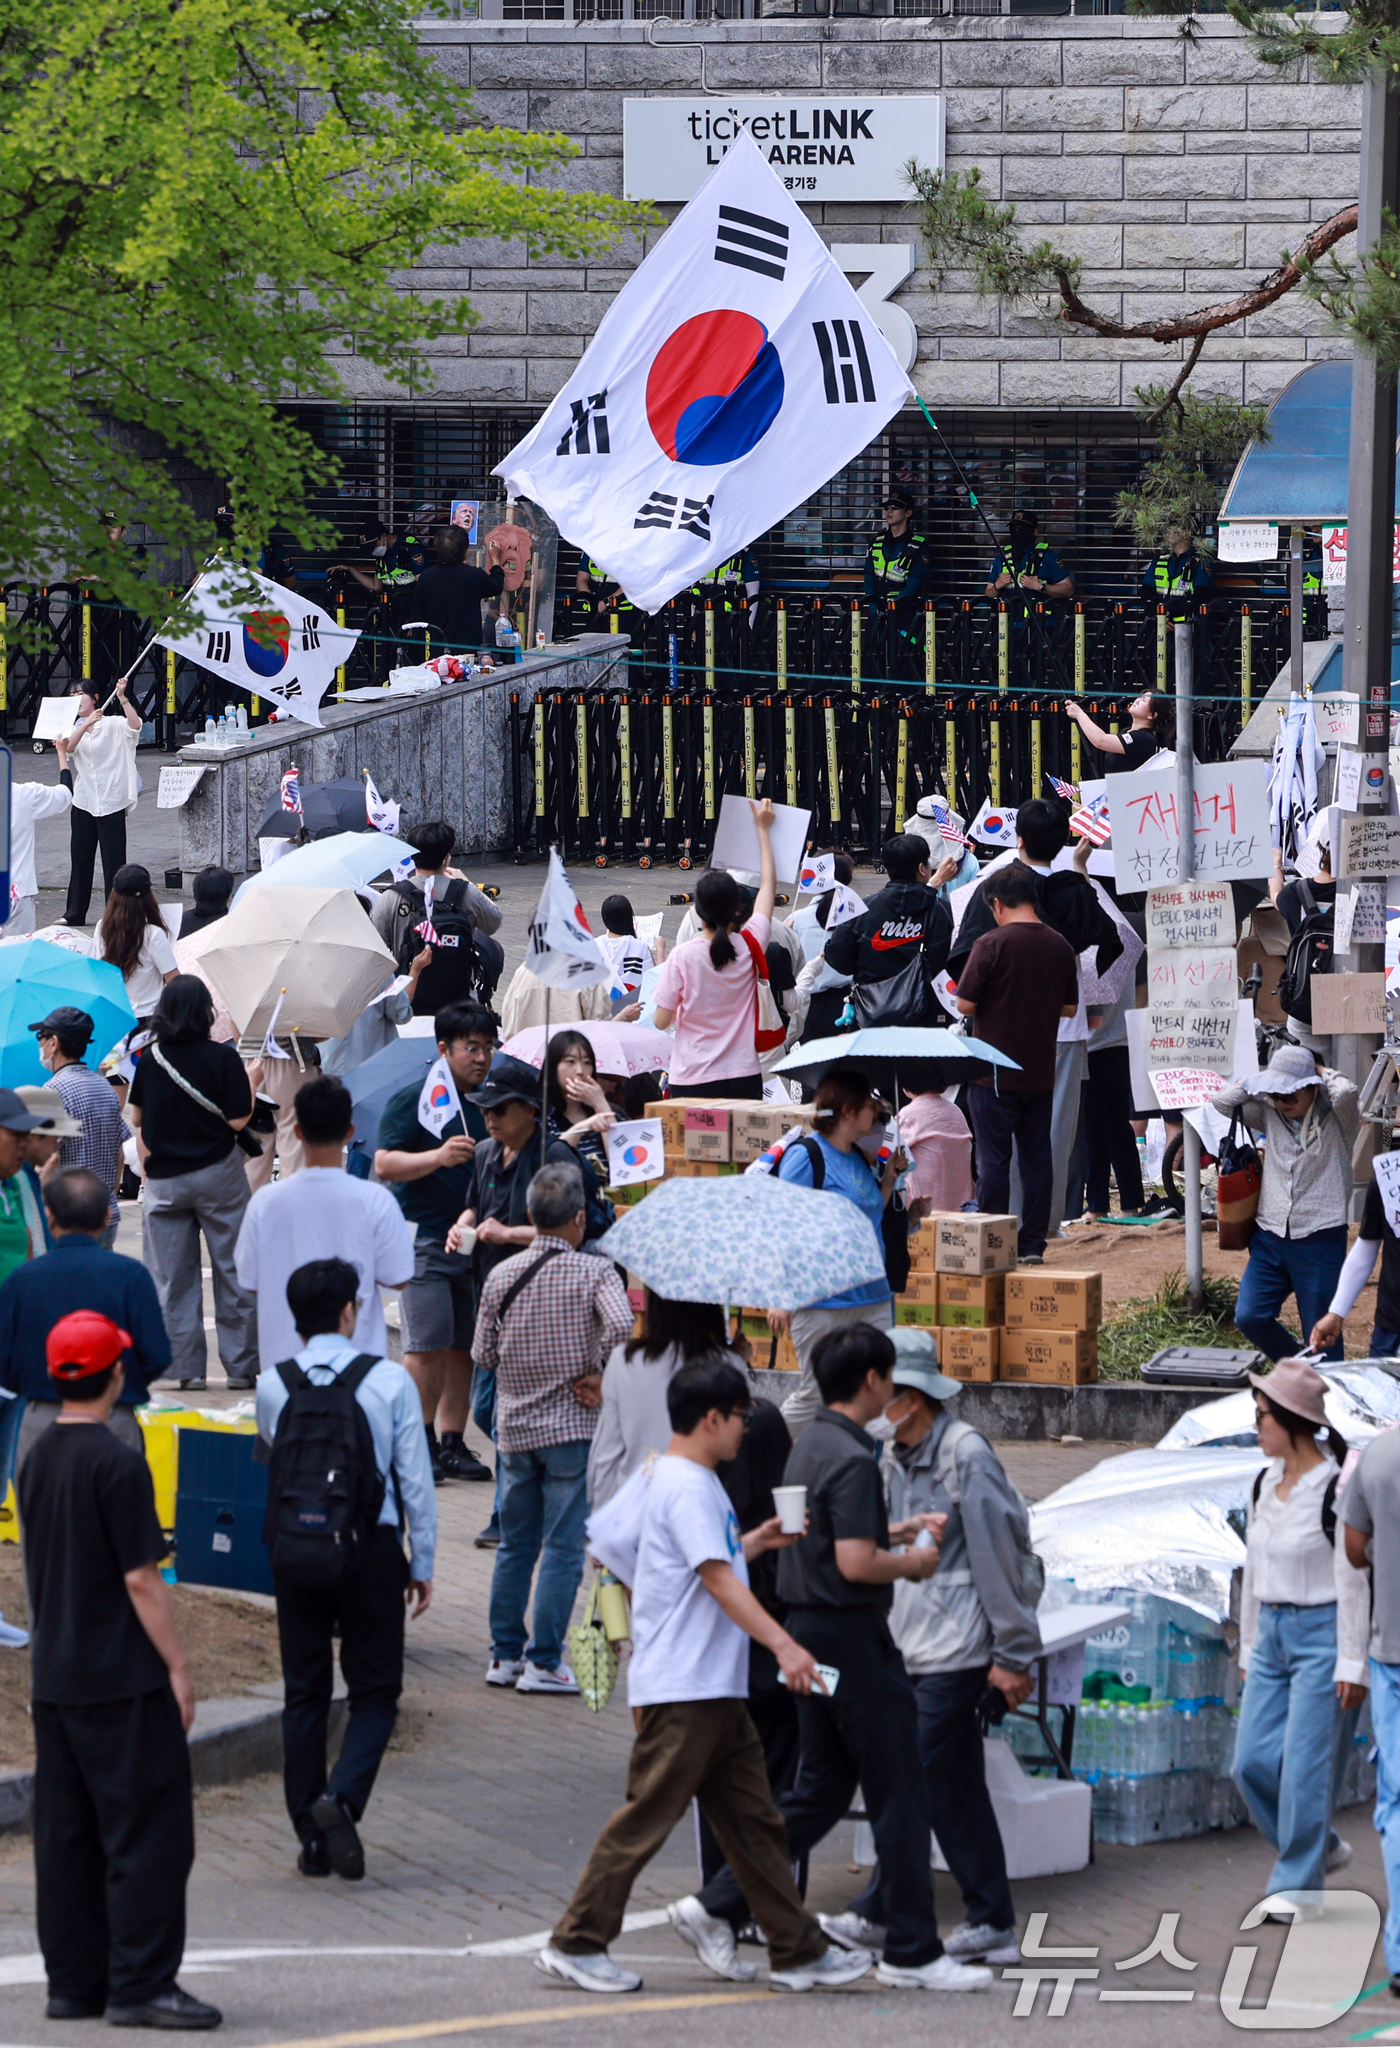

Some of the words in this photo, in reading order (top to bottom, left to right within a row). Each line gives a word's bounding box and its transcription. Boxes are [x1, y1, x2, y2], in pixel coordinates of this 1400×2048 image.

[688, 109, 874, 140] ticketLINK
[706, 144, 766, 165] LI
[769, 145, 855, 165] ARENA
[826, 728, 834, 773] POLICE
[1213, 836, 1261, 870] 보장
[880, 915, 922, 938] nike
[1151, 909, 1182, 927] CBDC
[1183, 998, 1201, 1008] the
[1151, 1015, 1185, 1033] 반드시
[1189, 1016, 1231, 1036] 재선거
